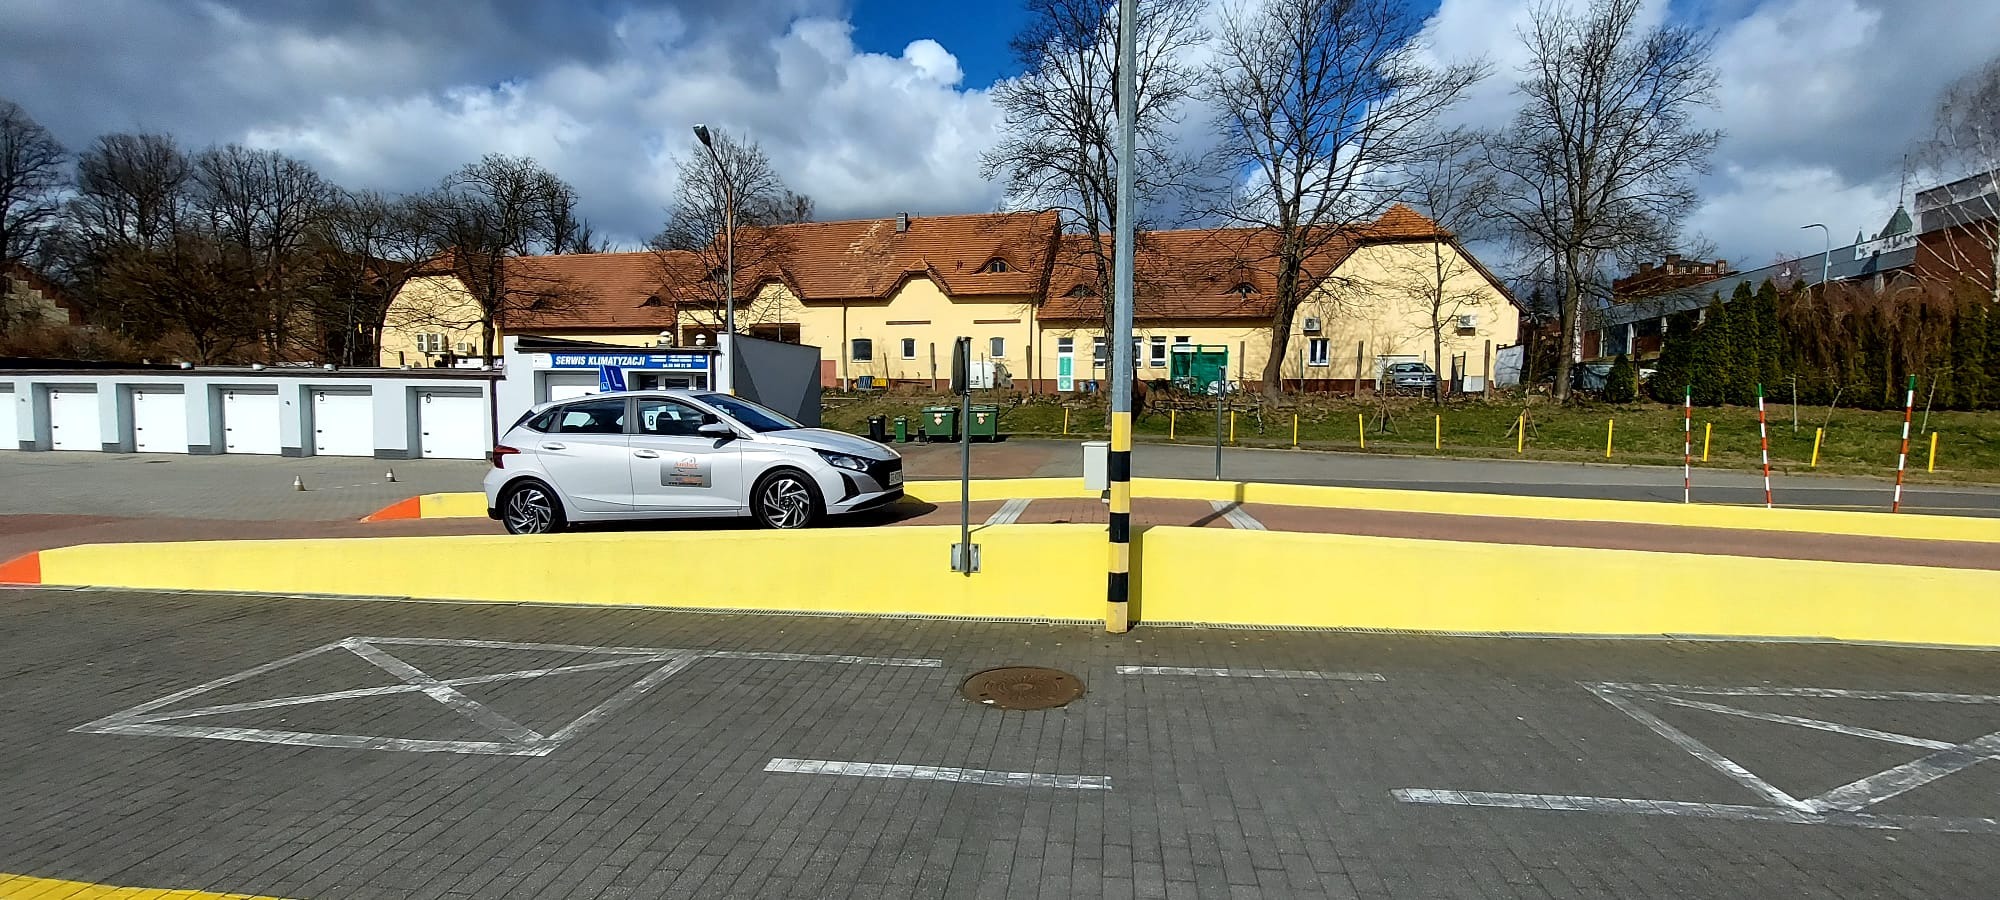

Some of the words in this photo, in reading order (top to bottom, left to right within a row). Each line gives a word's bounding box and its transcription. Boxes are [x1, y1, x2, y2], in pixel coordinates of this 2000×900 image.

[555, 355, 586, 366] SERWIS
[588, 355, 646, 366] KLIMATYZACJI
[610, 369, 623, 388] L
[53, 389, 59, 400] 2
[137, 390, 143, 401] 3
[228, 390, 234, 401] 4
[319, 391, 325, 402] 5
[425, 392, 432, 404] 6
[648, 415, 654, 426] 8
